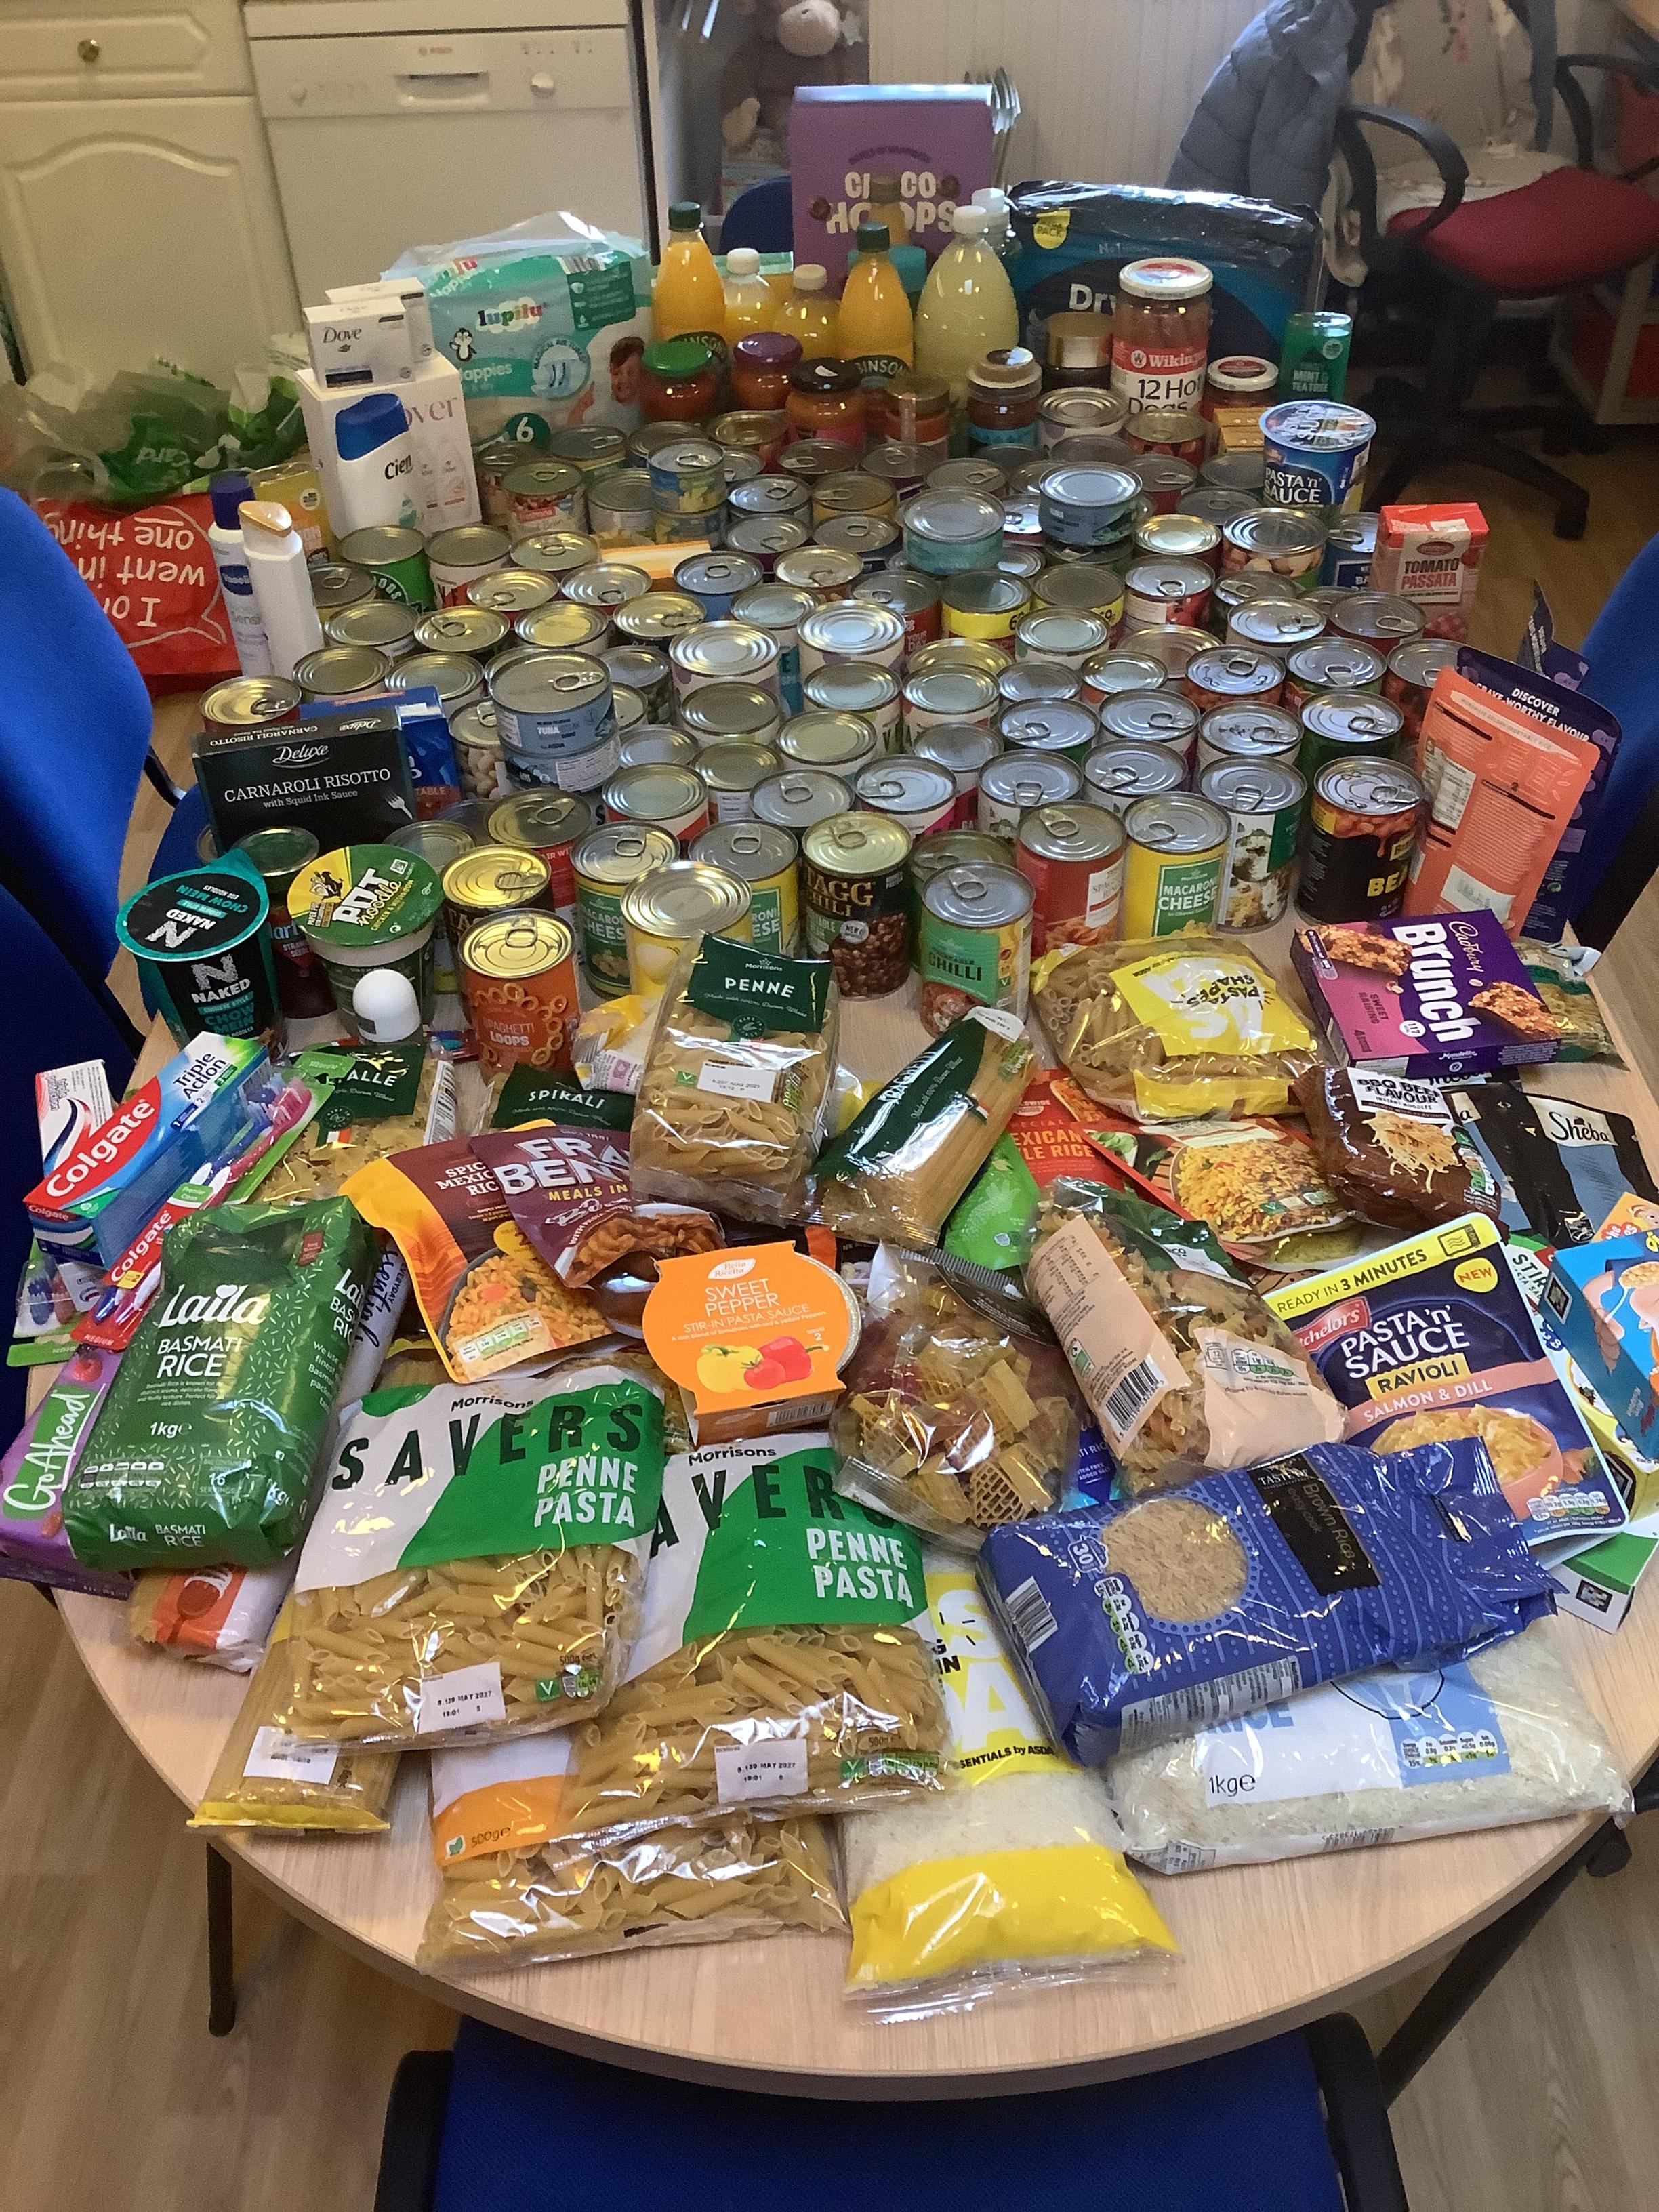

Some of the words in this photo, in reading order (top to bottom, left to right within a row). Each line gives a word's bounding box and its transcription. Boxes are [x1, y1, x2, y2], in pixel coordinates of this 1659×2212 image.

[477, 302, 544, 327] lupilu
[323, 327, 362, 344] Dove
[1138, 378, 1161, 400] 12
[516, 416, 534, 442] 6
[384, 453, 413, 480] Cien
[1265, 467, 1304, 489] PASTA
[1264, 480, 1322, 504] SAUCE
[135, 525, 194, 551] one
[117, 558, 205, 586] went
[1405, 558, 1460, 573] TOMATO
[1401, 573, 1457, 589] PASSATA
[136, 597, 161, 627] I
[1511, 687, 1561, 717] DISCOVER
[209, 733, 255, 747] RISOTTO
[255, 726, 319, 740] CARNAROLI
[272, 744, 329, 764] Deluxe
[224, 779, 321, 802] CARNAROLI
[325, 768, 391, 786] RISOTTO
[263, 798, 285, 809] with
[285, 794, 319, 807] Squid
[321, 792, 336, 803] Ink
[338, 789, 365, 801] Sauce
[175, 884, 210, 901] MEIN
[209, 896, 249, 914] CHOW
[332, 867, 392, 926] POT
[356, 880, 402, 927] noodle
[1158, 886, 1218, 911] CHEESE
[166, 908, 217, 930] NAKED
[145, 920, 198, 949] N
[1448, 920, 1484, 972] Cadbury
[191, 953, 239, 991] N
[745, 962, 783, 972] Morrisons
[928, 951, 982, 982] CHILLI
[191, 978, 251, 1004] NAKED
[725, 977, 795, 998] PENNE
[1391, 922, 1482, 1043] Brunch
[205, 1002, 255, 1025] CHOW
[1370, 993, 1389, 1021] SWEET
[213, 1014, 255, 1035] MEIN
[489, 1031, 530, 1047] LOOPS
[173, 1052, 217, 1088] Triple
[183, 1057, 227, 1100] Action
[1366, 1085, 1439, 1104] FLAVOUR
[1010, 1129, 1084, 1146] EXICAN
[1549, 1110, 1611, 1143] Sheba
[46, 1099, 157, 1197] Colgate
[1050, 1144, 1095, 1158] RICE
[435, 1170, 494, 1192] MEXIC
[444, 1162, 486, 1179] SPIC
[469, 1180, 500, 1197] RIC
[548, 1186, 602, 1202] MEALS
[609, 1183, 628, 1195] IN
[28, 1204, 70, 1221] Colgate
[110, 1210, 173, 1284] Colgate
[1277, 1292, 1320, 1314] READY
[1323, 1285, 1339, 1298] IN
[1340, 1279, 1351, 1292] 3
[1353, 1248, 1428, 1288] MINUTES
[1458, 1266, 1492, 1284] NEW
[705, 1278, 770, 1303] SWEET
[159, 1283, 271, 1328] Laila
[704, 1292, 780, 1318] PEPPER
[683, 1317, 724, 1335] STIR-IN
[726, 1311, 766, 1326] PASTA
[767, 1302, 811, 1320] SAUCE
[157, 1335, 243, 1355] BASMATI
[1340, 1309, 1425, 1357] PASTA
[1345, 1324, 1471, 1379] SAUCE
[157, 1354, 226, 1378] RICE
[1378, 1359, 1460, 1394] RAVIOLI
[451, 1394, 535, 1412] Morrisons
[1363, 1391, 1435, 1424] SALMON
[1438, 1389, 1450, 1401] &
[1455, 1378, 1494, 1399] DILL
[331, 1404, 642, 1491] SAVERS
[688, 1446, 777, 1467] Morrisons
[537, 1455, 638, 1495] PENNE
[533, 1490, 636, 1528] PASTA
[1302, 1482, 1337, 1527] Brown
[1331, 1528, 1355, 1559] Rice
[109, 1523, 148, 1542] Laila
[155, 1524, 206, 1536] BASMATI
[164, 1534, 203, 1547] RICE
[806, 1528, 908, 1570] PENNE
[1073, 1542, 1094, 1566] 30
[813, 1564, 914, 1609] PASTA
[1013, 1744, 1025, 1756] by
[1027, 1745, 1054, 1756] ASDA
